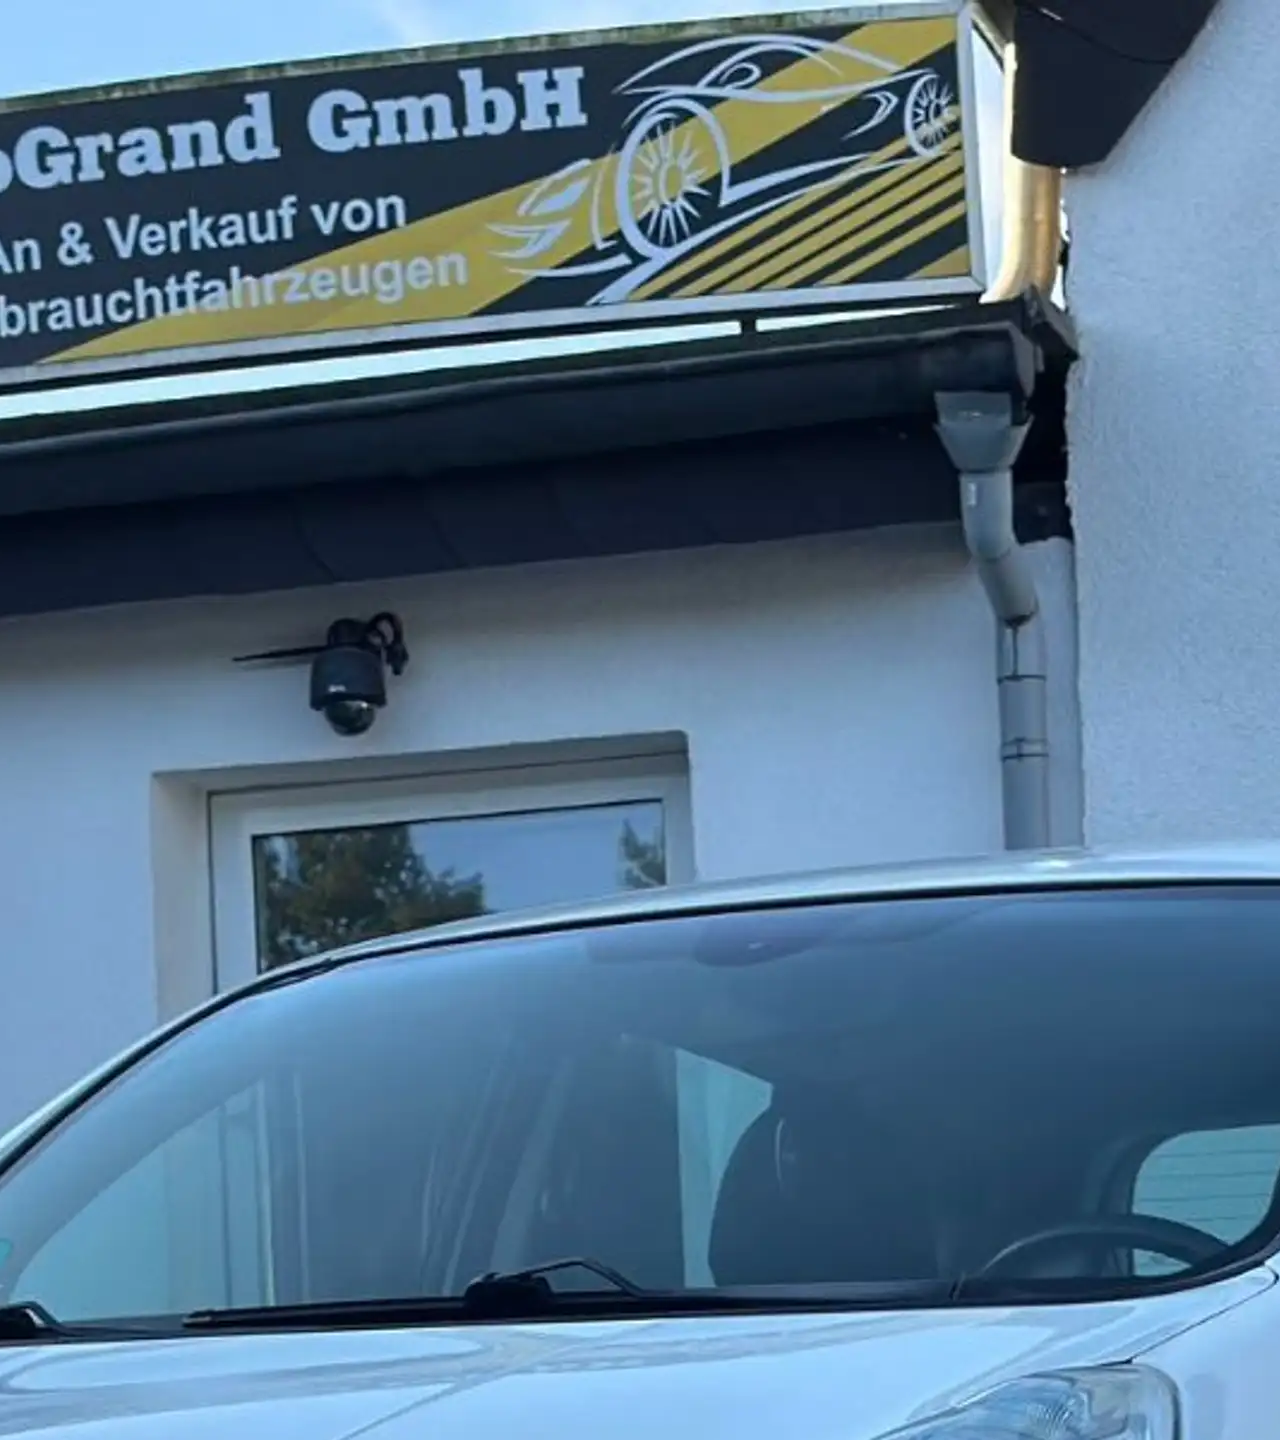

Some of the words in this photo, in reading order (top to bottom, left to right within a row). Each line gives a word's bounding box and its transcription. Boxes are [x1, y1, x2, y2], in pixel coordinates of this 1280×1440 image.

[307, 66, 588, 153] GmbH
[56, 221, 94, 268] &
[104, 195, 298, 260] Verkauf
[310, 193, 407, 235] von
